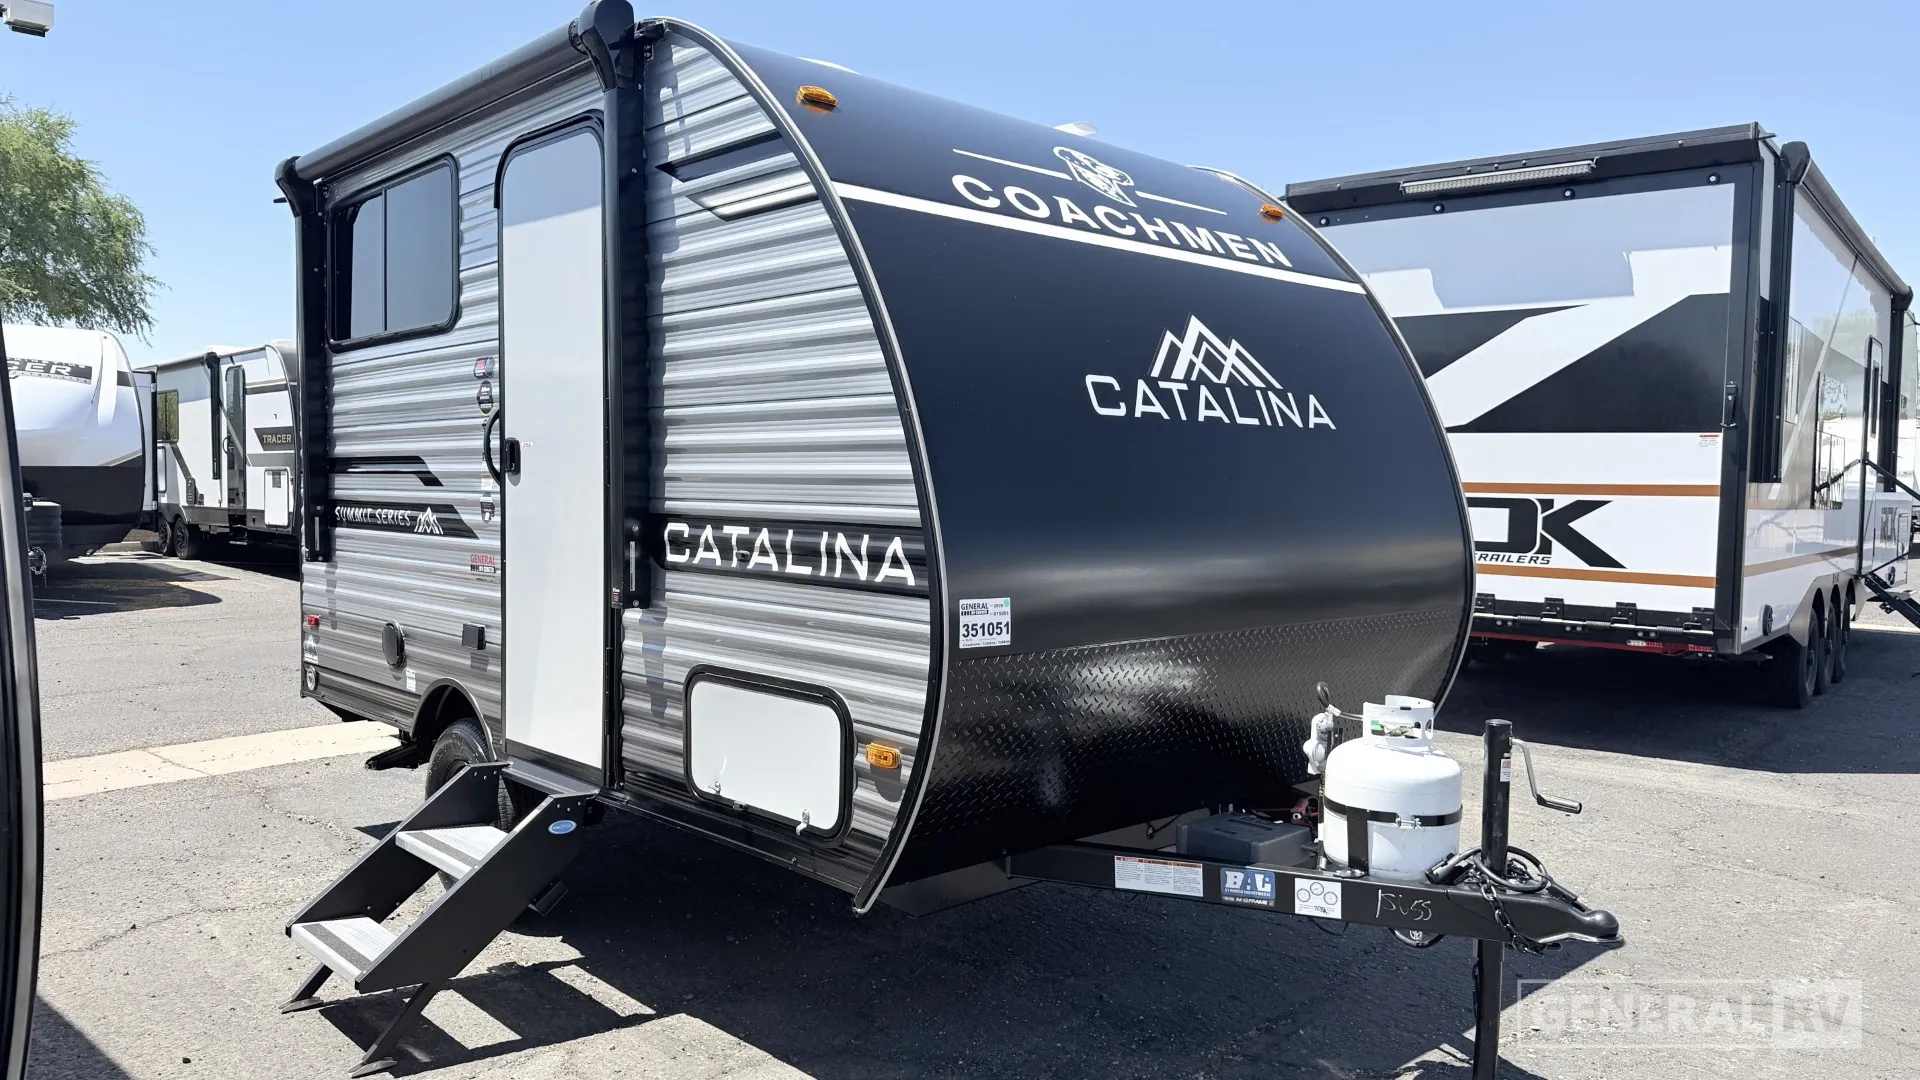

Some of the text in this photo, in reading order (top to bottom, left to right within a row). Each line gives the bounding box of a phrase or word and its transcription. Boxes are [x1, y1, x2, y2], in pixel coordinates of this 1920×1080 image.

[952, 174, 1293, 268] COACHMEN
[1085, 374, 1337, 430] CATALINA
[262, 434, 292, 444] TRACER
[334, 506, 411, 527] SUMMIT SERIES
[470, 553, 496, 566] GENERAL
[664, 522, 916, 587] CATALINA
[1475, 553, 1552, 566] RAILERS
[960, 603, 989, 611] GENERAL
[962, 621, 1010, 638] 351051
[1225, 870, 1271, 893] BAL
